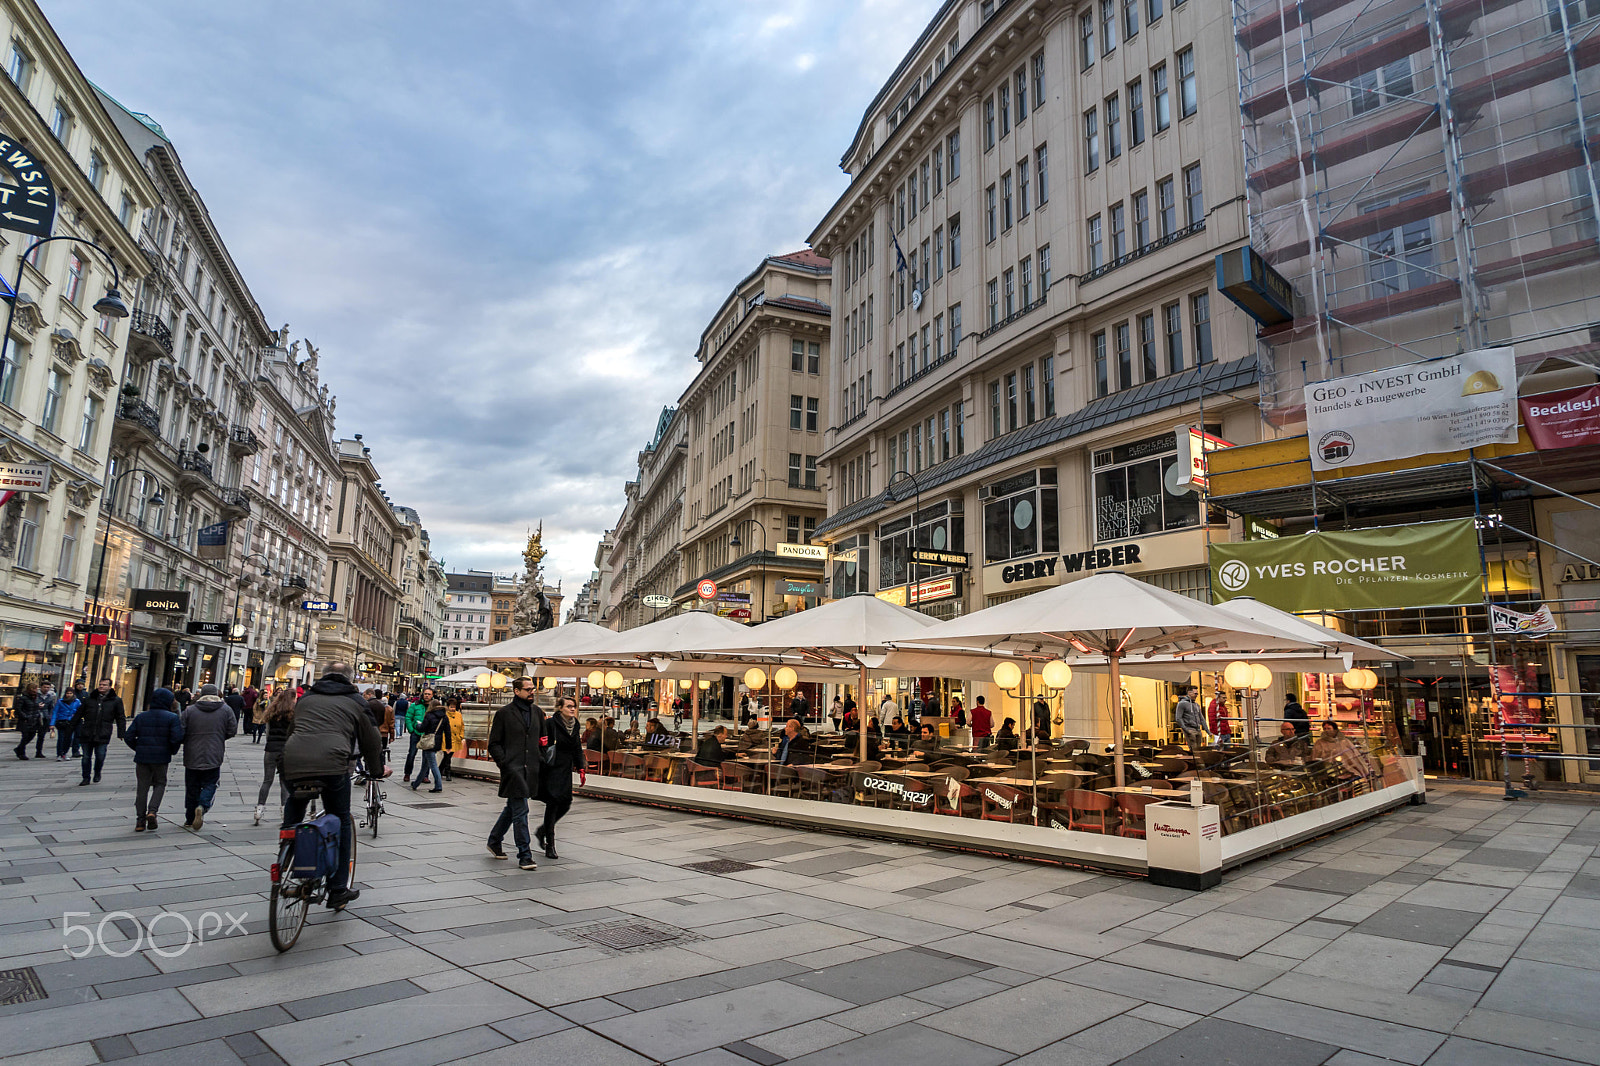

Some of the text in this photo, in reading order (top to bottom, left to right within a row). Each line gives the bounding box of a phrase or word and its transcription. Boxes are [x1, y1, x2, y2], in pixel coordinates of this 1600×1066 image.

[1313, 387, 1347, 403] GEO
[1359, 373, 1414, 395] INVEST
[1418, 364, 1462, 383] GmbH
[1314, 386, 1427, 414] Handels & Baugewerbe
[7, 467, 43, 476] HILGER
[0, 478, 41, 487] EISEN
[1097, 495, 1114, 506] IHR
[1097, 493, 1161, 515] INVESTMENT
[1098, 525, 1140, 540] SEIT 1972
[783, 546, 822, 556] PANDORA
[940, 553, 967, 564] WEBER
[1001, 543, 1142, 584] GERRY WEBER
[1255, 555, 1407, 579] YVES ROCHER
[1561, 563, 1600, 582] AL
[787, 583, 815, 595] Douglas
[202, 623, 219, 632] IWC
